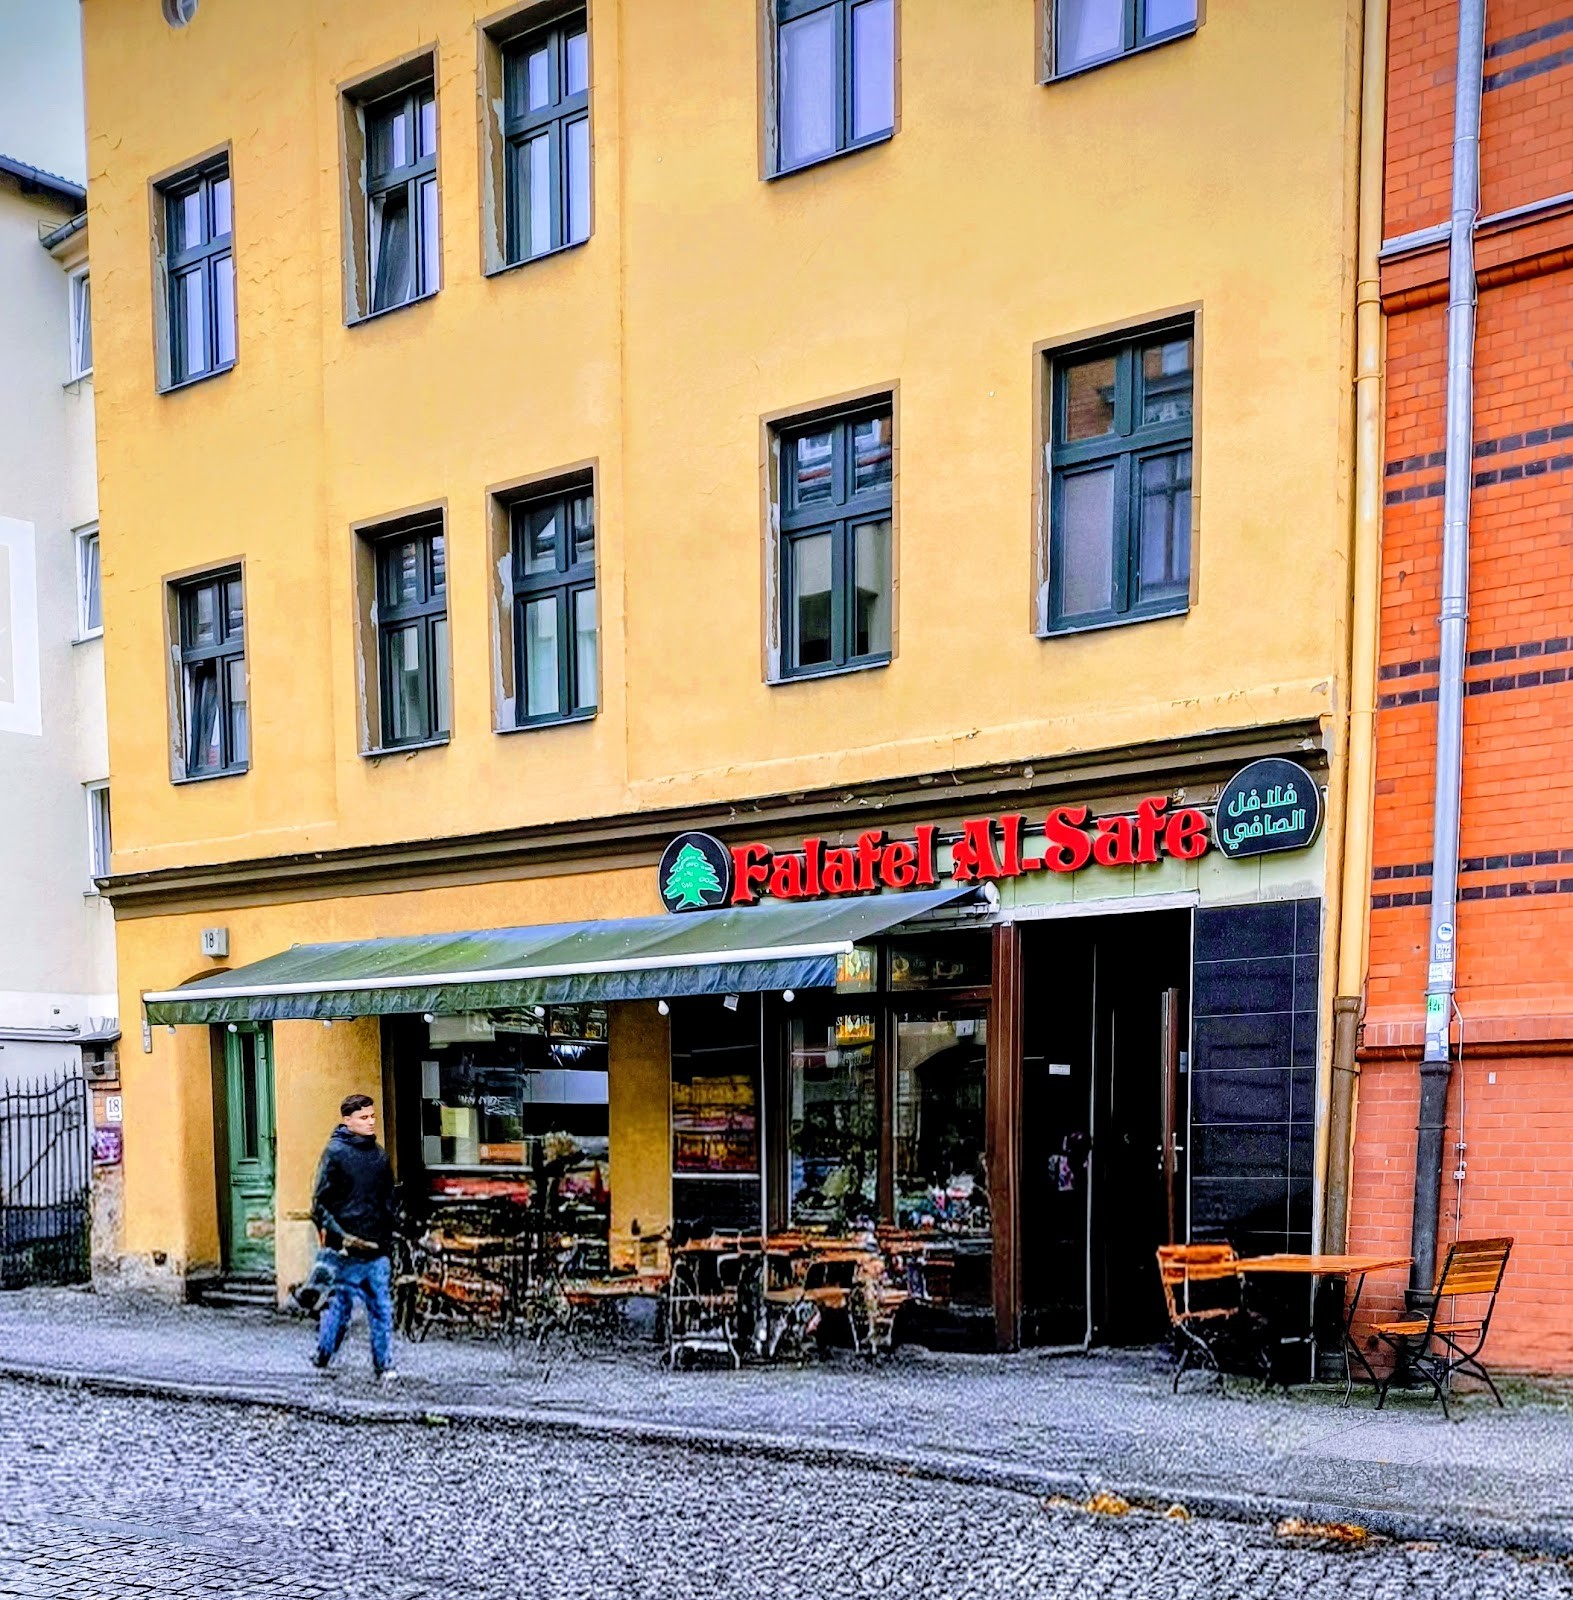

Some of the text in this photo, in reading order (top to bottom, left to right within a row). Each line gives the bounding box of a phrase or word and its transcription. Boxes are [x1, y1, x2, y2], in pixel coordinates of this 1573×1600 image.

[1228, 783, 1297, 817] فلافل
[1223, 809, 1306, 850] الصافي
[731, 824, 936, 904] Falafel
[205, 932, 215, 949] 18
[108, 1099, 120, 1113] 18
